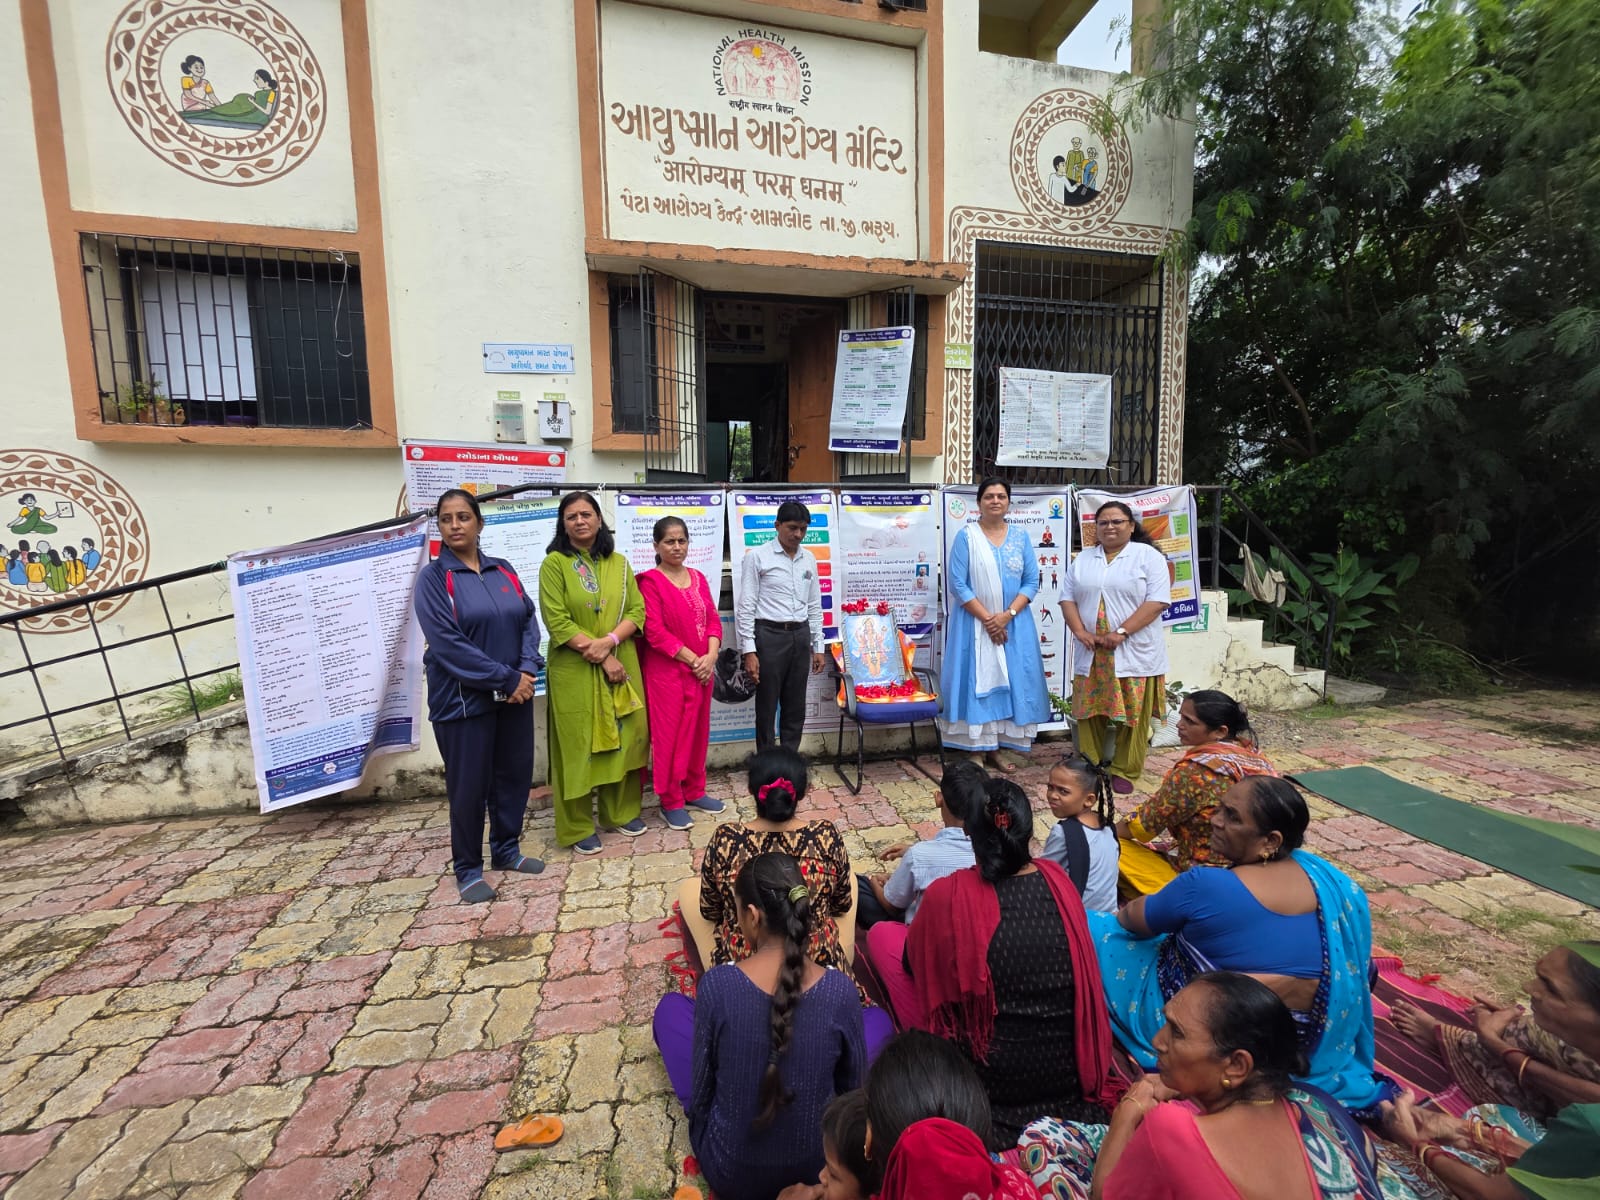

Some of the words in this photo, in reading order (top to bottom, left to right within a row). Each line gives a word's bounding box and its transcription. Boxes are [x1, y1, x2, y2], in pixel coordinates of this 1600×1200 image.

[712, 35, 735, 96] NATIONAL
[738, 28, 786, 46] HEALTH
[790, 46, 812, 106] MISSION
[610, 102, 739, 155] આયુષ્માન
[746, 116, 838, 164] આરોગ્ય
[845, 125, 908, 175] મંદિર
[620, 188, 650, 214] પેટા
[653, 193, 712, 220] આરોગ્ય
[753, 170, 797, 201] परम्
